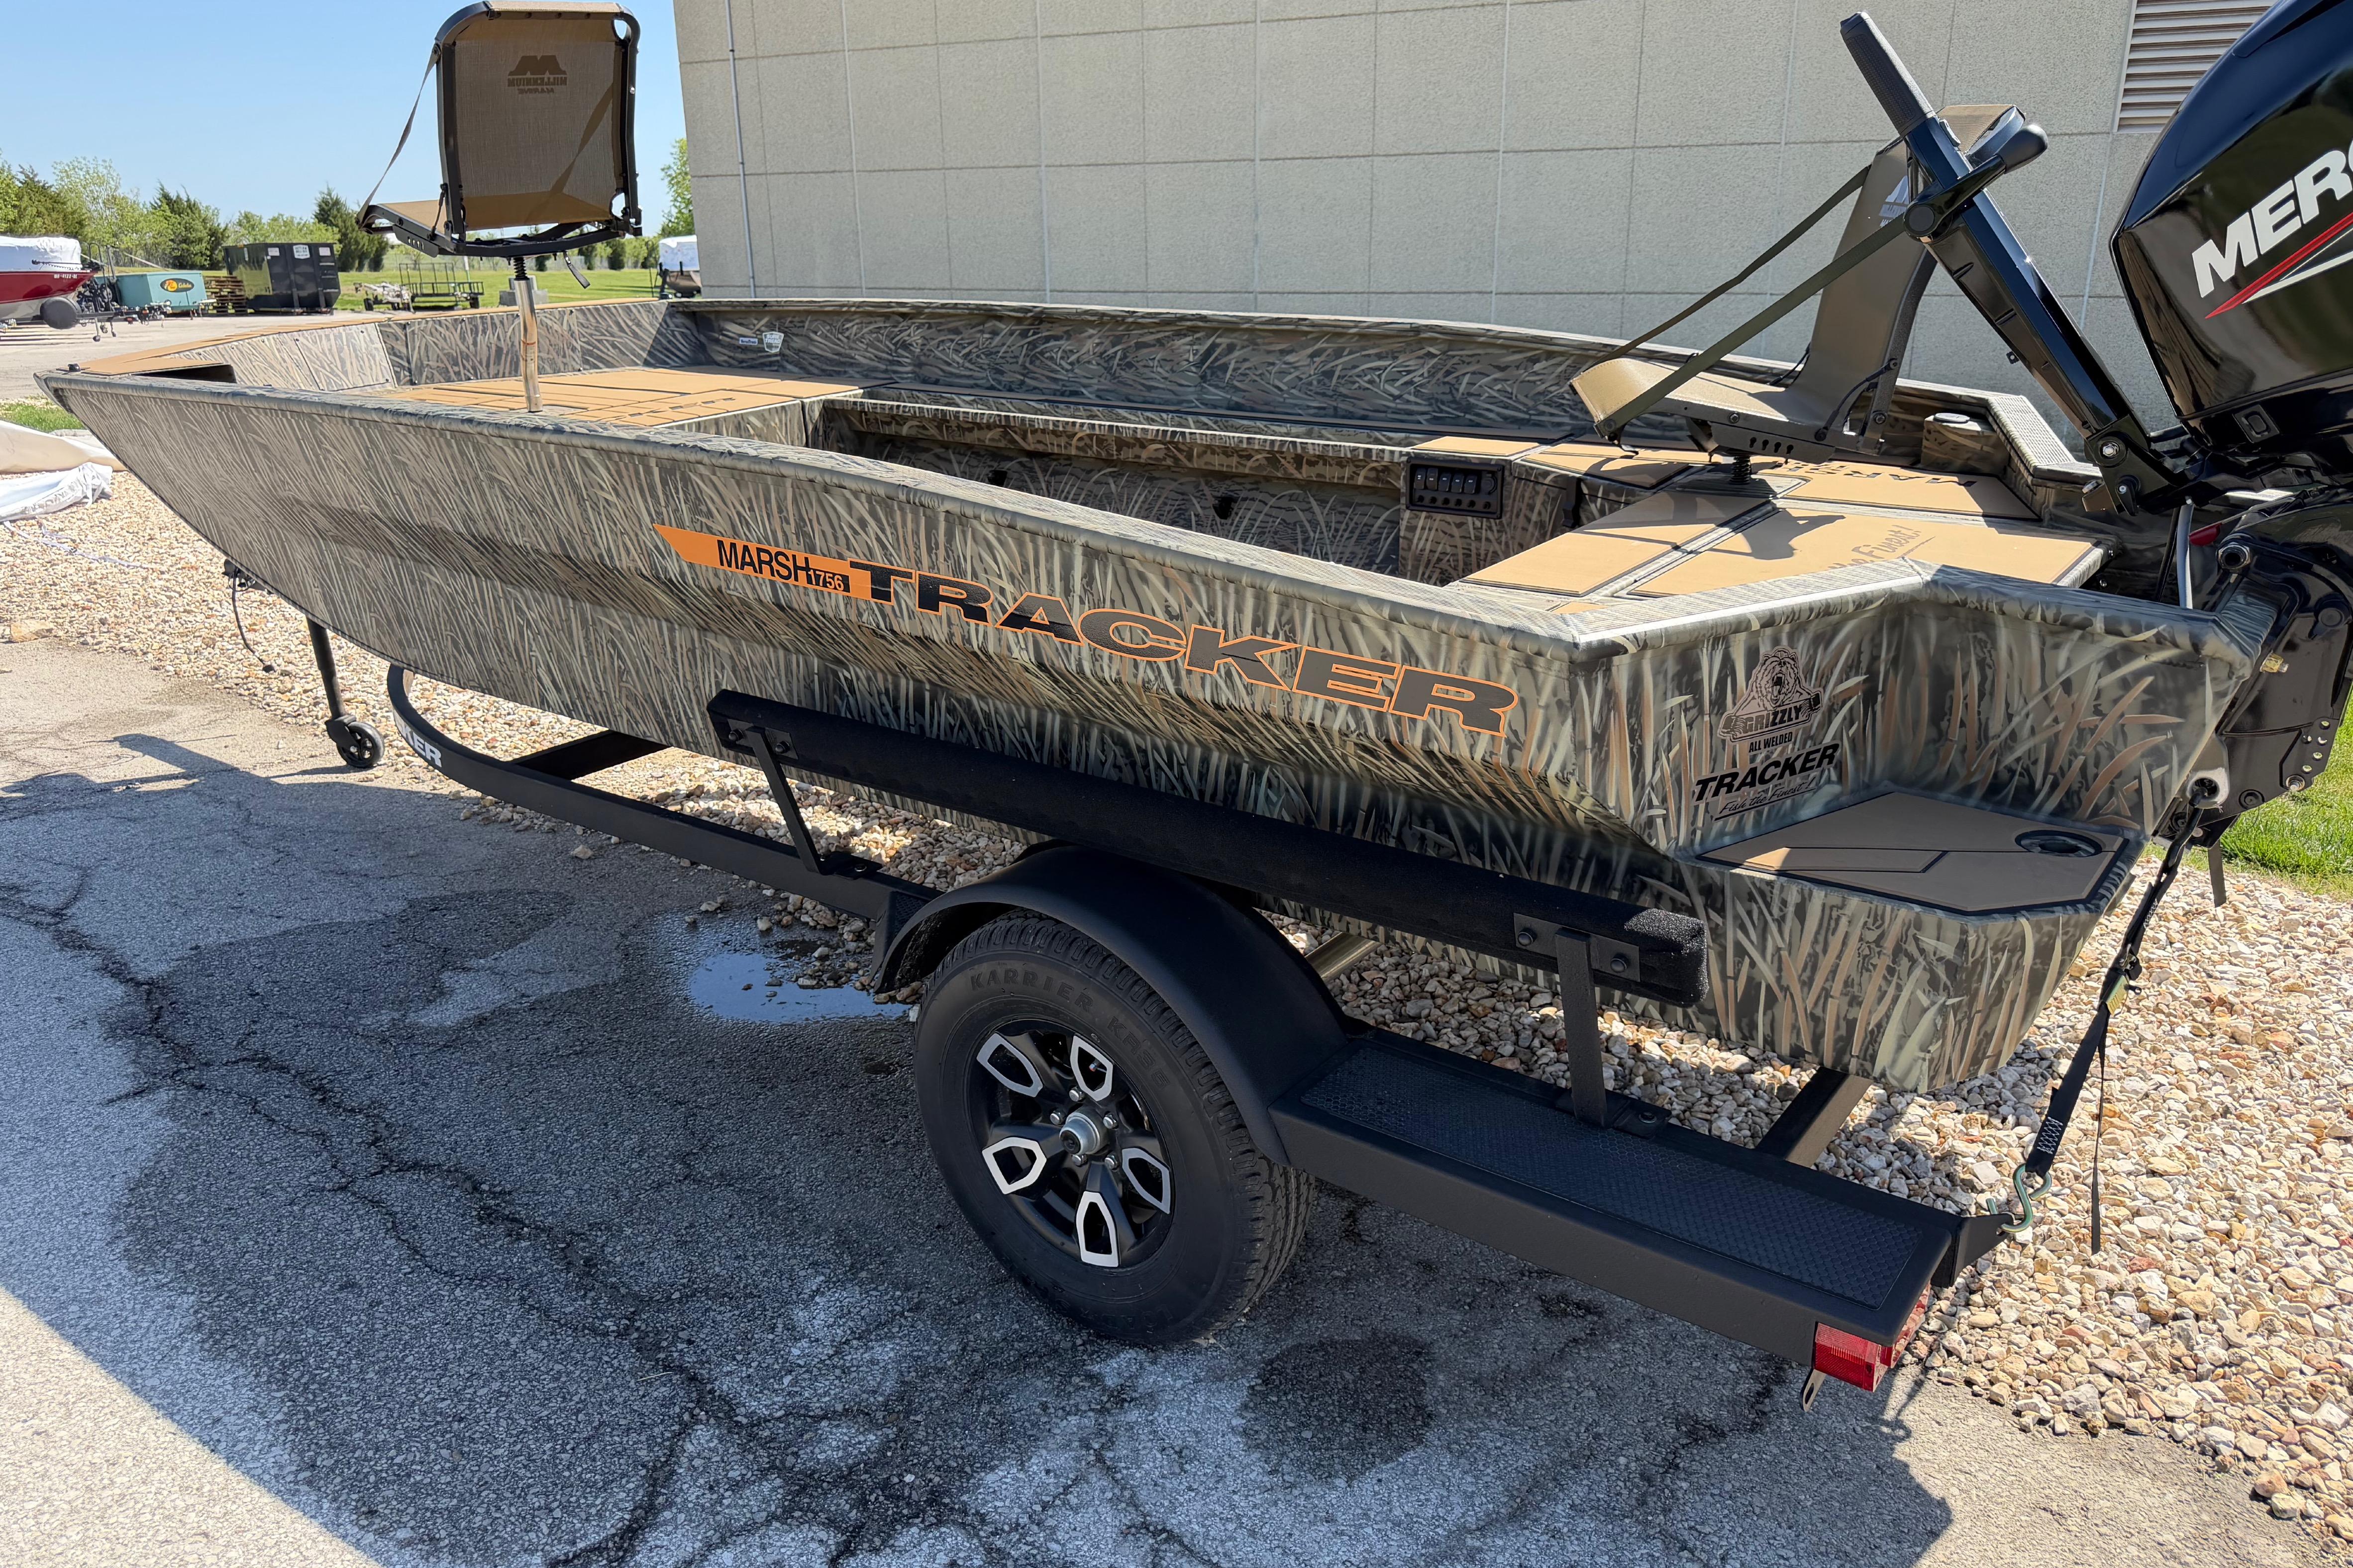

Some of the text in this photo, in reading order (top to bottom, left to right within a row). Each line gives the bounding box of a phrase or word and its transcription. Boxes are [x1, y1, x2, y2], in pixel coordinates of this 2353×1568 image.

[2192, 135, 2353, 298] MER
[716, 539, 1519, 738] MARSH 1756 TRACKER
[1741, 704, 1803, 735] GRIZZLY
[1748, 731, 1793, 753] ALL WELDED
[1694, 743, 1840, 802] TRACKER
[1719, 798, 1748, 814] Fish
[1749, 791, 1767, 806] the
[970, 967, 1096, 1013] KARRIER
